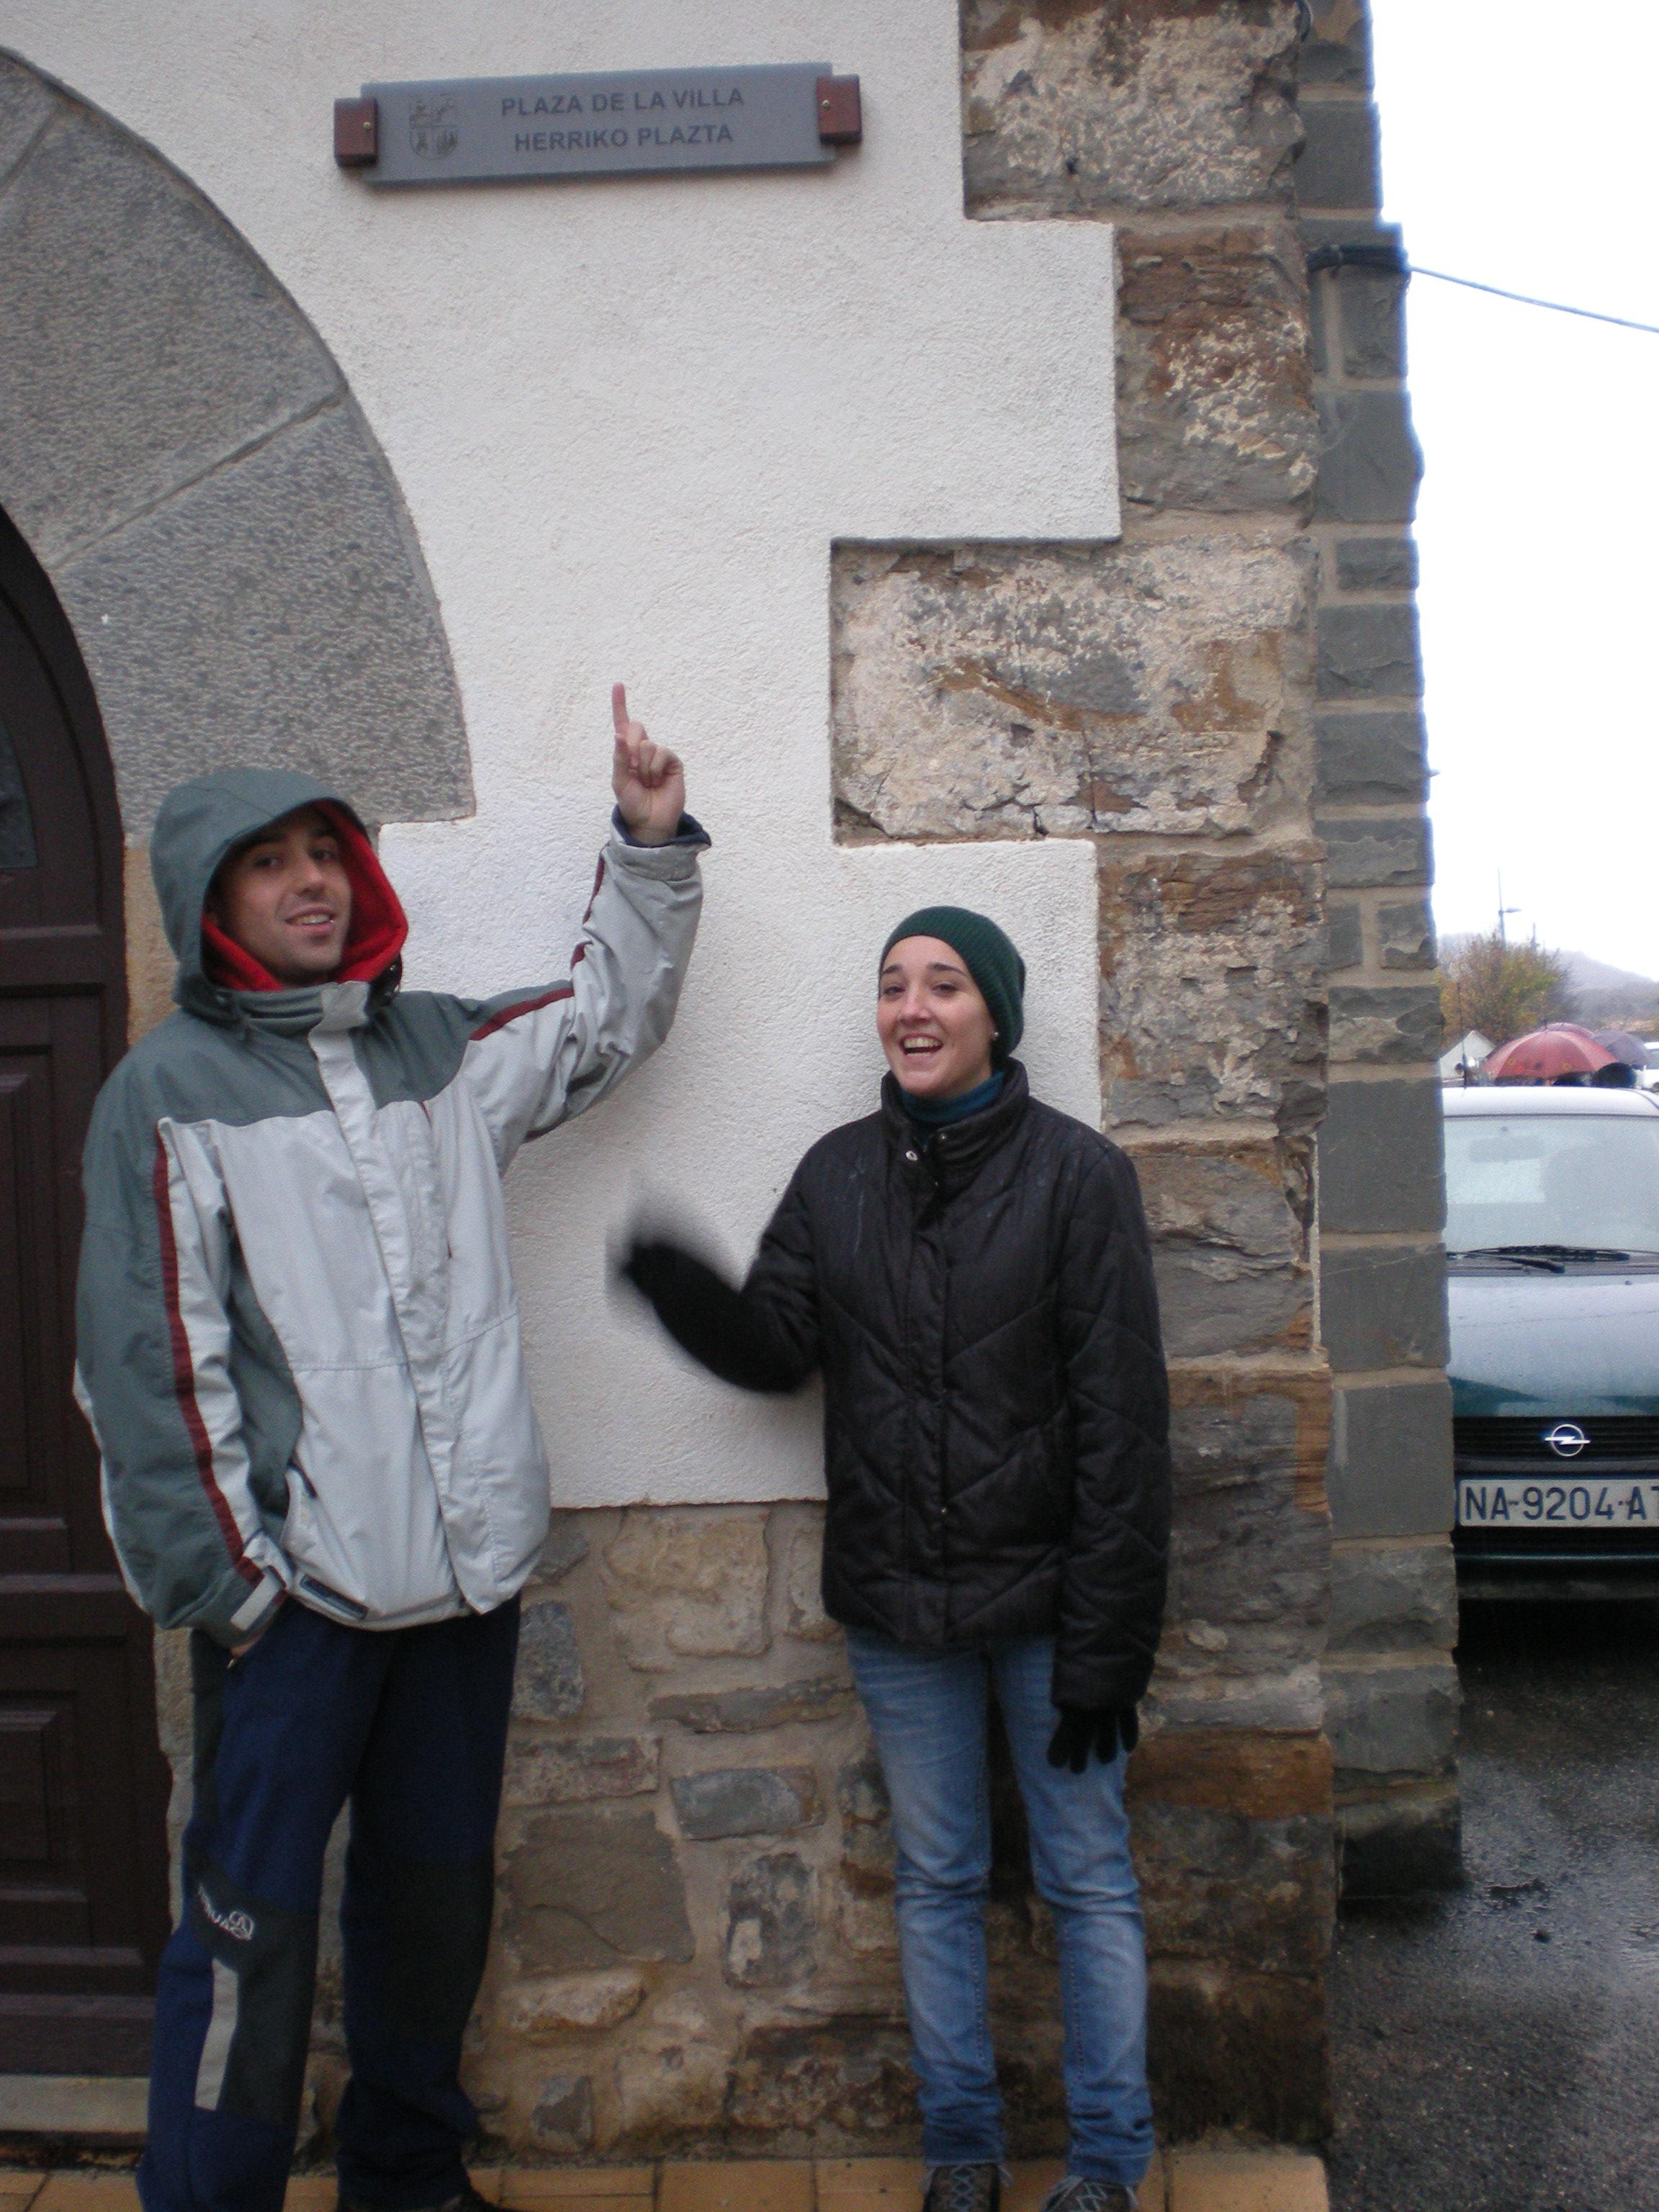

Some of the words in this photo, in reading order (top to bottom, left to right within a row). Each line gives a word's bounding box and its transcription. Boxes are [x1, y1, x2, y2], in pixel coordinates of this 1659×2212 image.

[501, 94, 583, 116] PLAZA
[591, 91, 624, 112] DE
[634, 91, 666, 110] LA
[673, 87, 745, 109] VILLA
[514, 127, 629, 151] HERRIKO
[637, 123, 734, 147] PLAZTA
